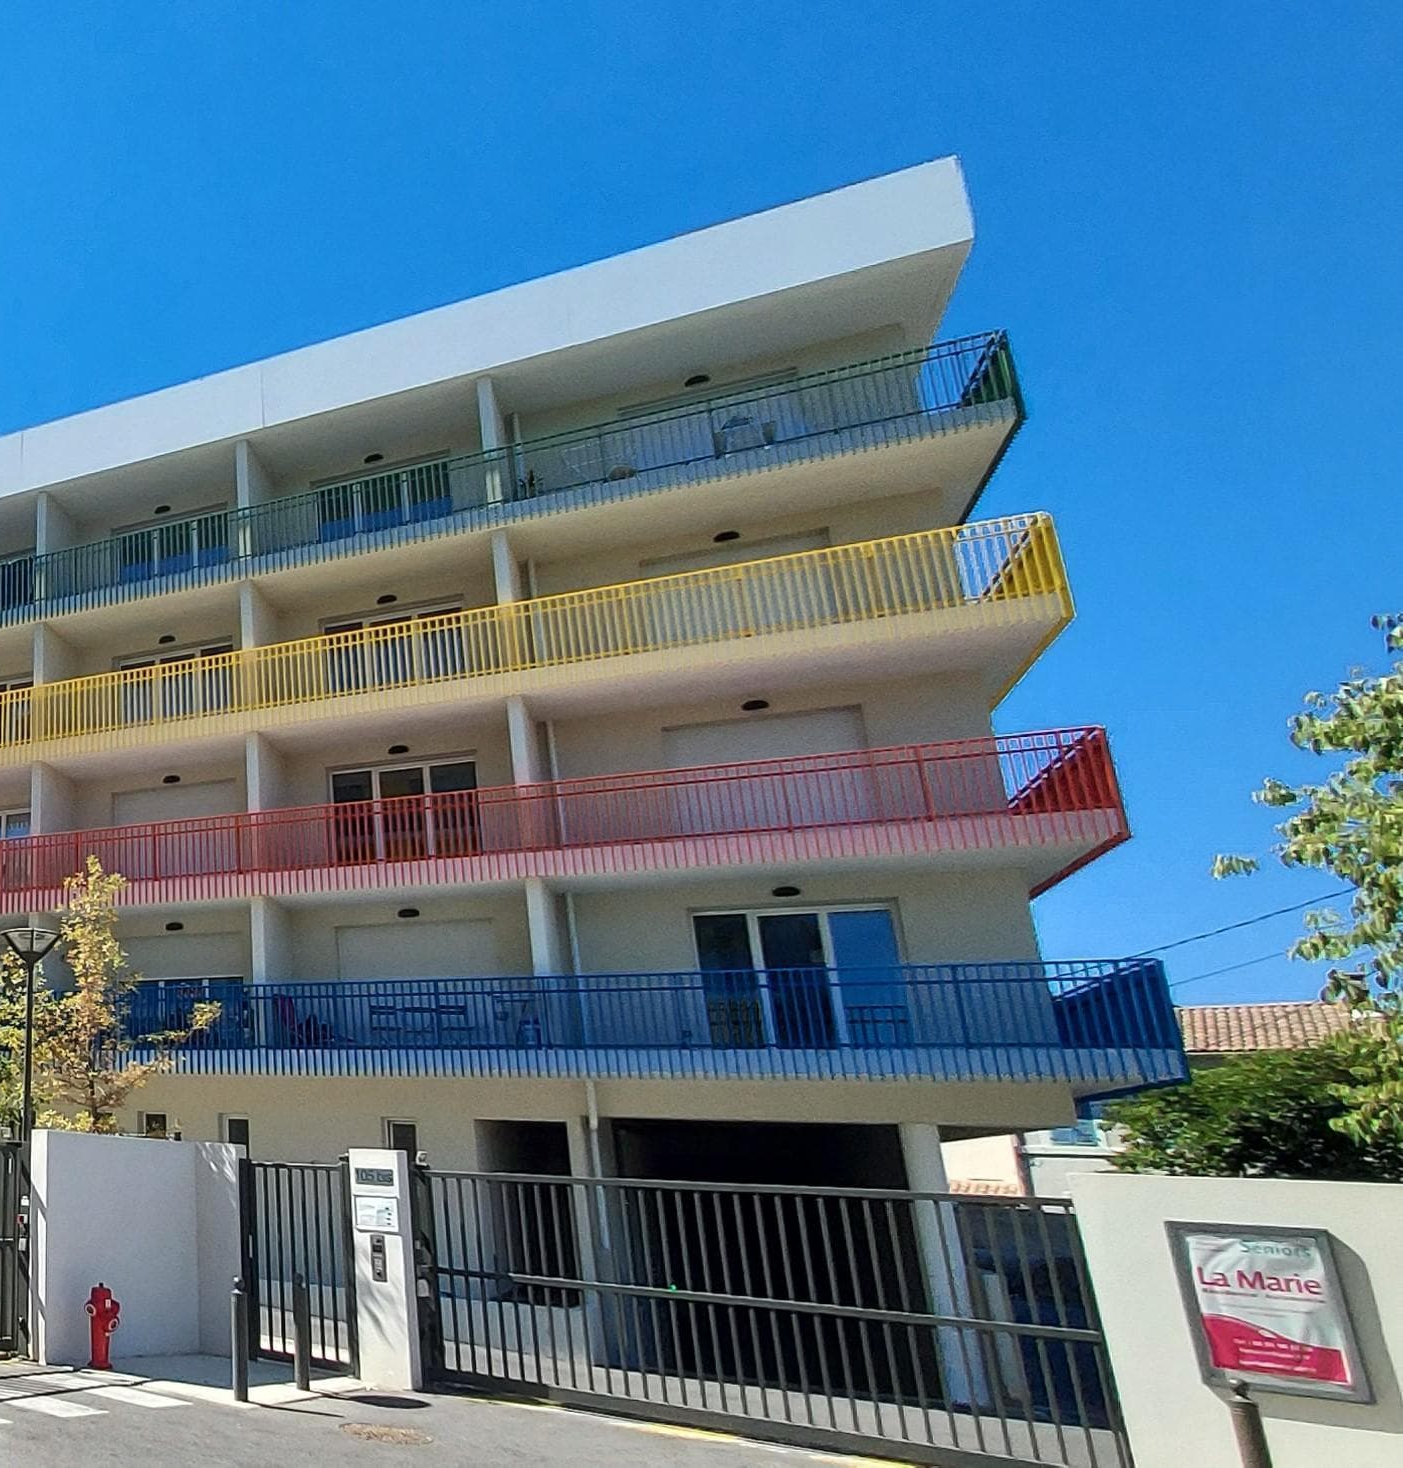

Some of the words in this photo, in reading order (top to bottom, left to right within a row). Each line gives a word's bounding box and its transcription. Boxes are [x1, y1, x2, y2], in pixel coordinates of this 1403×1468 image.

[1239, 1241, 1312, 1258] Seniors
[1196, 1266, 1231, 1288] La
[1236, 1269, 1324, 1296] Marie
